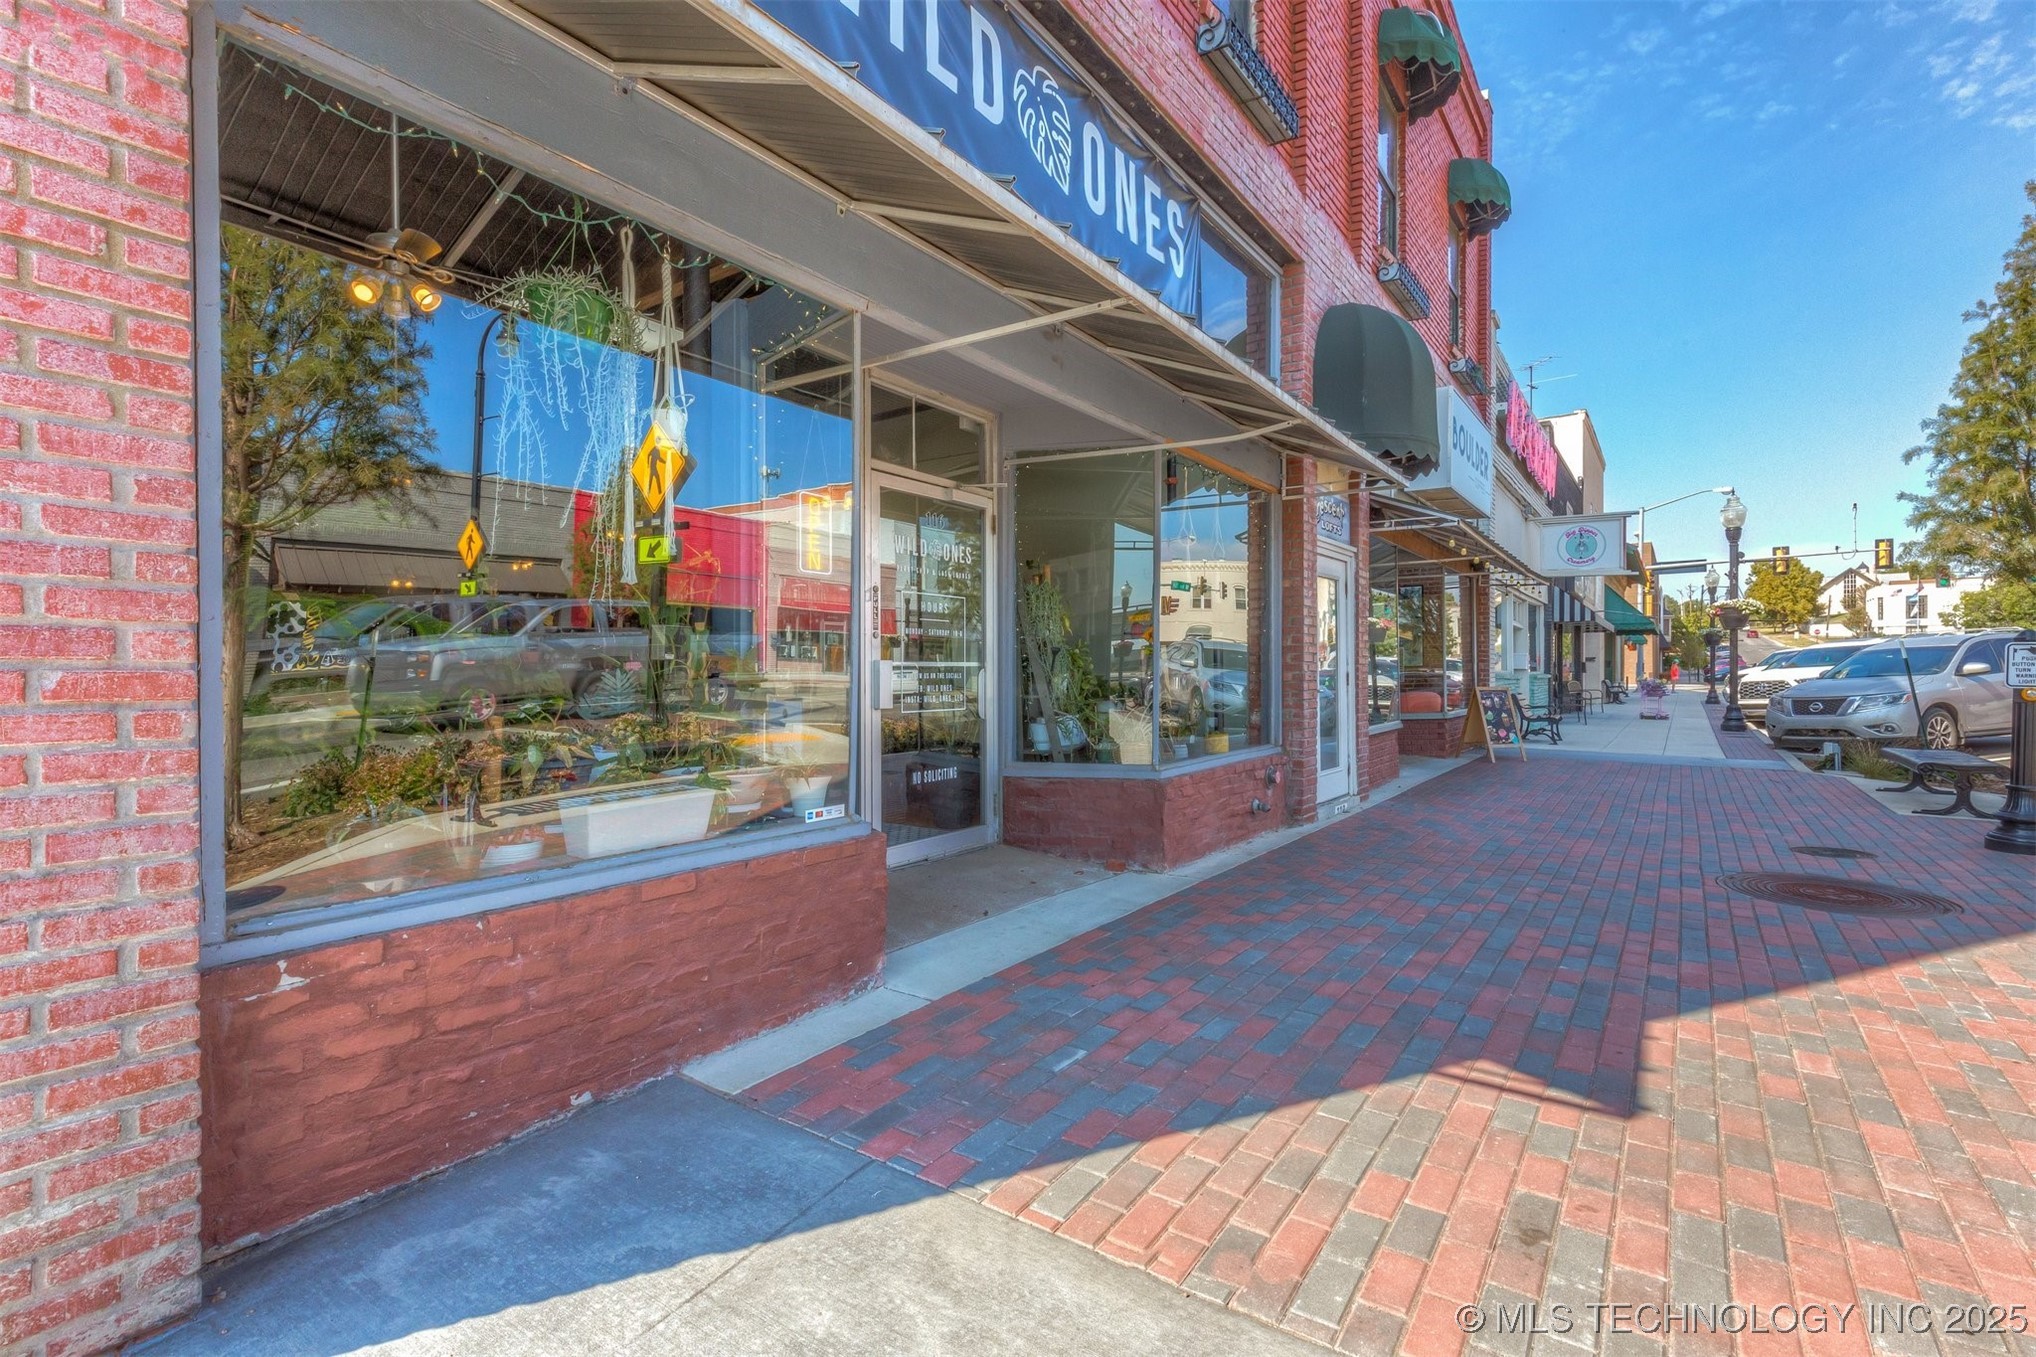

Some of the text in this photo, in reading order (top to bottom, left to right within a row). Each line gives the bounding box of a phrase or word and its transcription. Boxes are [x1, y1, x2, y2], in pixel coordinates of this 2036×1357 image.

[826, 0, 1184, 279] LD ONES
[1452, 415, 1489, 481] BOULDER
[1315, 500, 1345, 519] rescent
[925, 511, 945, 529] 116
[1321, 520, 1343, 536] LOFTS
[895, 535, 972, 564] WILD ONES
[921, 601, 949, 613] HOURS
[912, 766, 957, 784] NO SOLICITING
